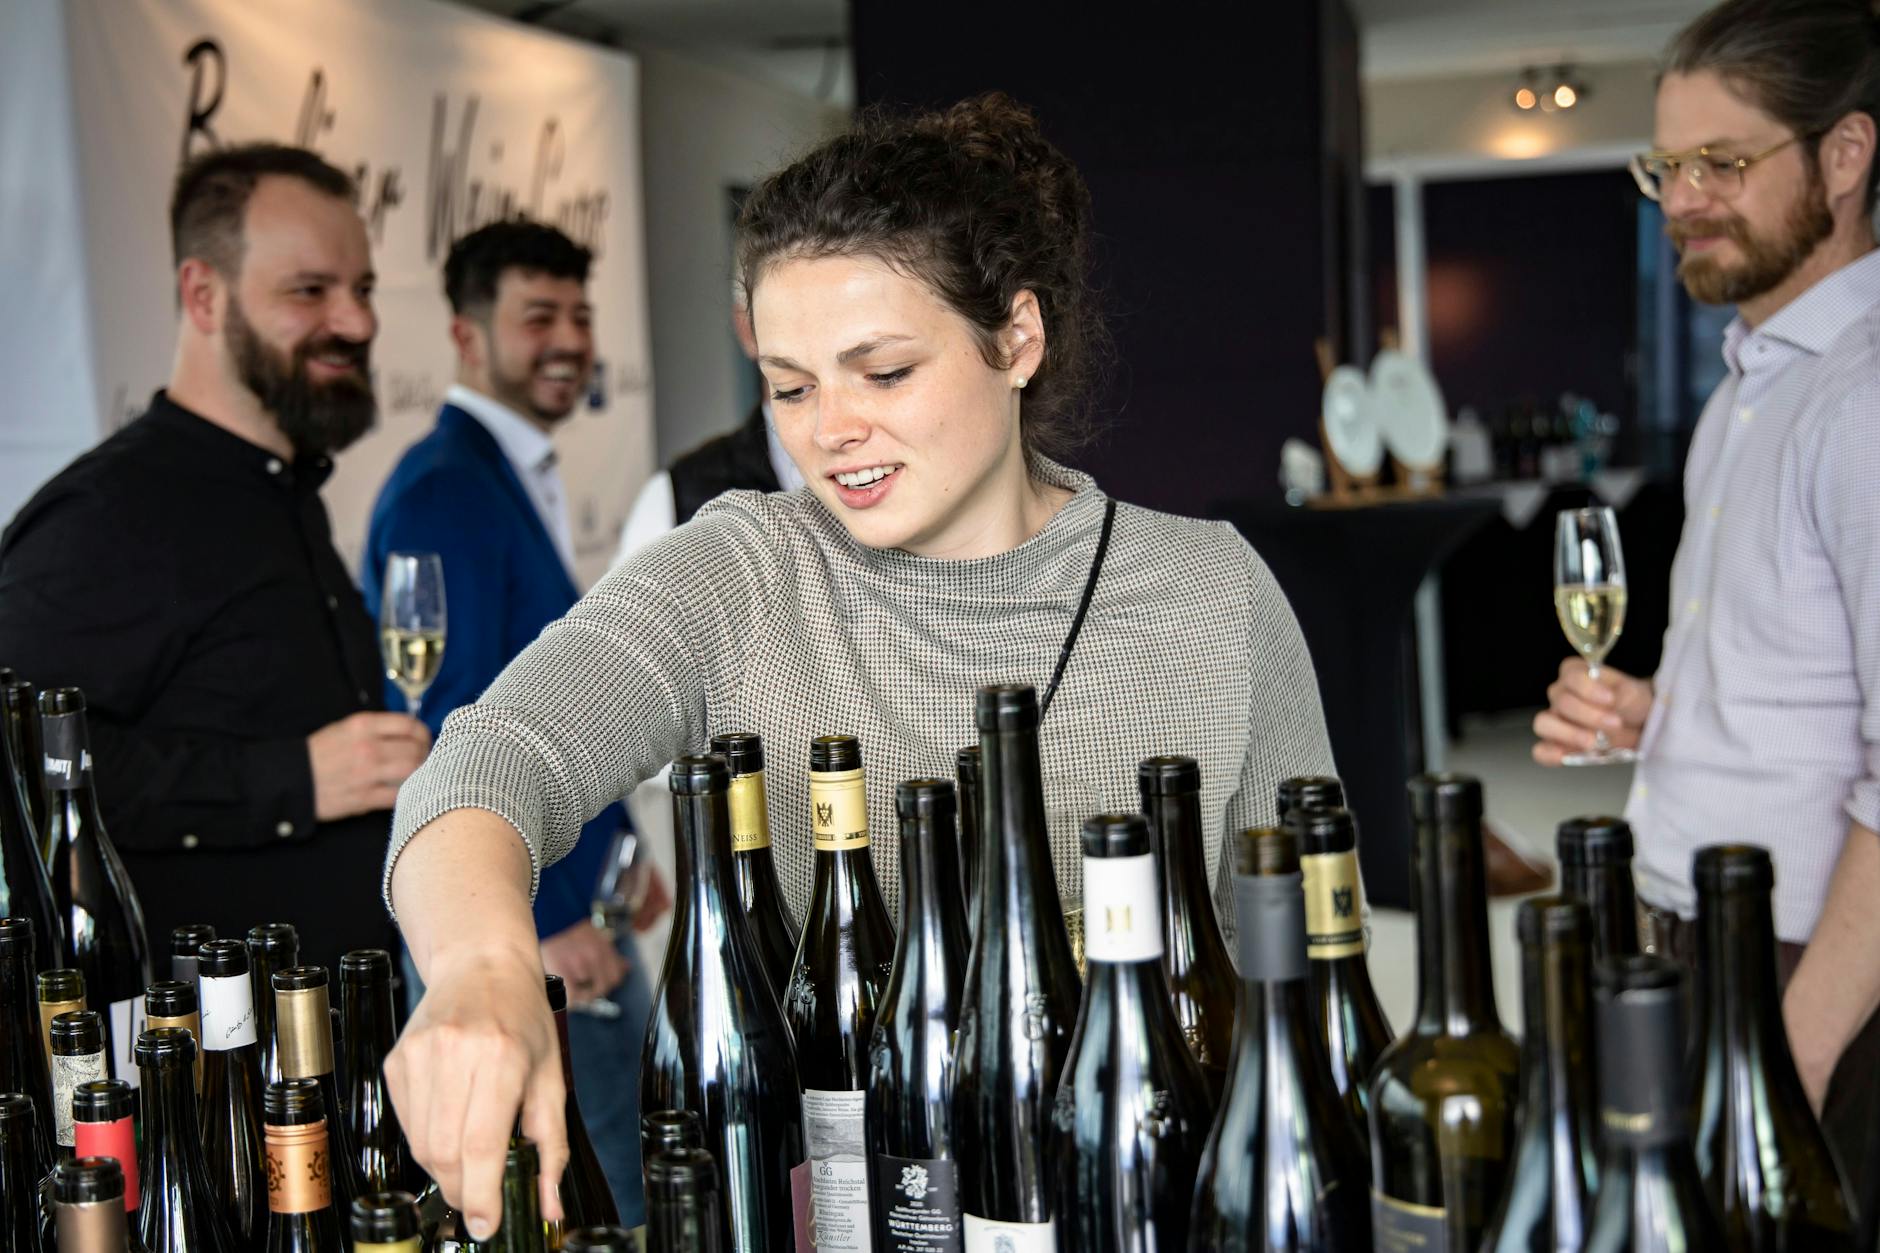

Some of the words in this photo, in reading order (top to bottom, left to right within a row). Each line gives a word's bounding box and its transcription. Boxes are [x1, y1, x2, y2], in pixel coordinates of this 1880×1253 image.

[819, 1166, 833, 1176] GG
[888, 1219, 953, 1232] WÜRTTEMBERG
[816, 1230, 851, 1242] Künstler
